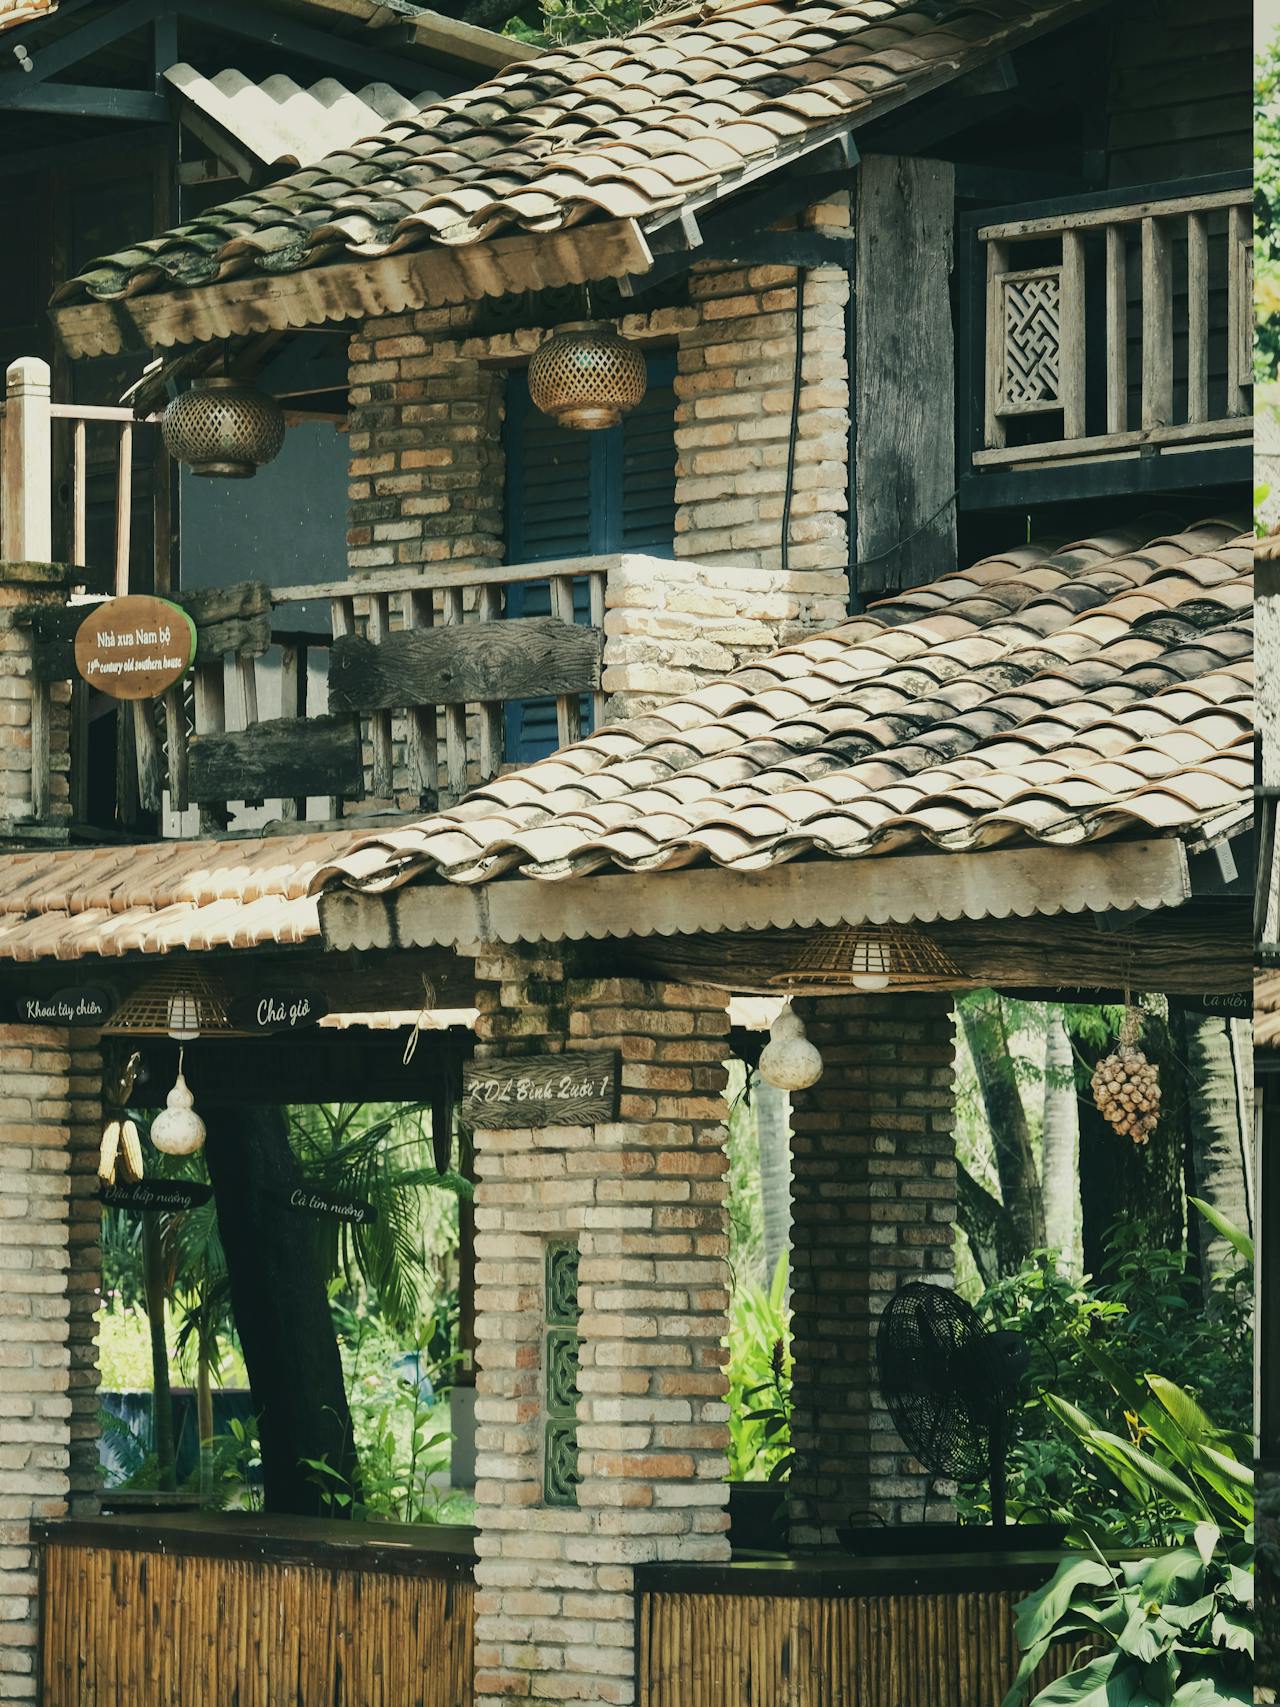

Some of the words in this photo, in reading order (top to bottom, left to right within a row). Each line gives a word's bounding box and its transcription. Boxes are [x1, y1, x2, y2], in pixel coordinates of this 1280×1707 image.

[97, 630, 116, 648] Nhà
[117, 633, 134, 647] xưa
[135, 628, 157, 645] Nam
[159, 626, 170, 646] bộ
[100, 661, 123, 675] century
[124, 657, 134, 672] old
[135, 656, 162, 671] southern
[163, 654, 181, 669] house
[26, 1000, 57, 1019] Khoai
[58, 1001, 74, 1021] tây
[76, 997, 103, 1016] chiên
[257, 998, 287, 1026] Chả
[289, 998, 310, 1027] giò
[467, 1078, 513, 1103] KDL
[516, 1078, 553, 1101] Bình
[599, 1075, 609, 1097] 1
[290, 1188, 307, 1206] Cà
